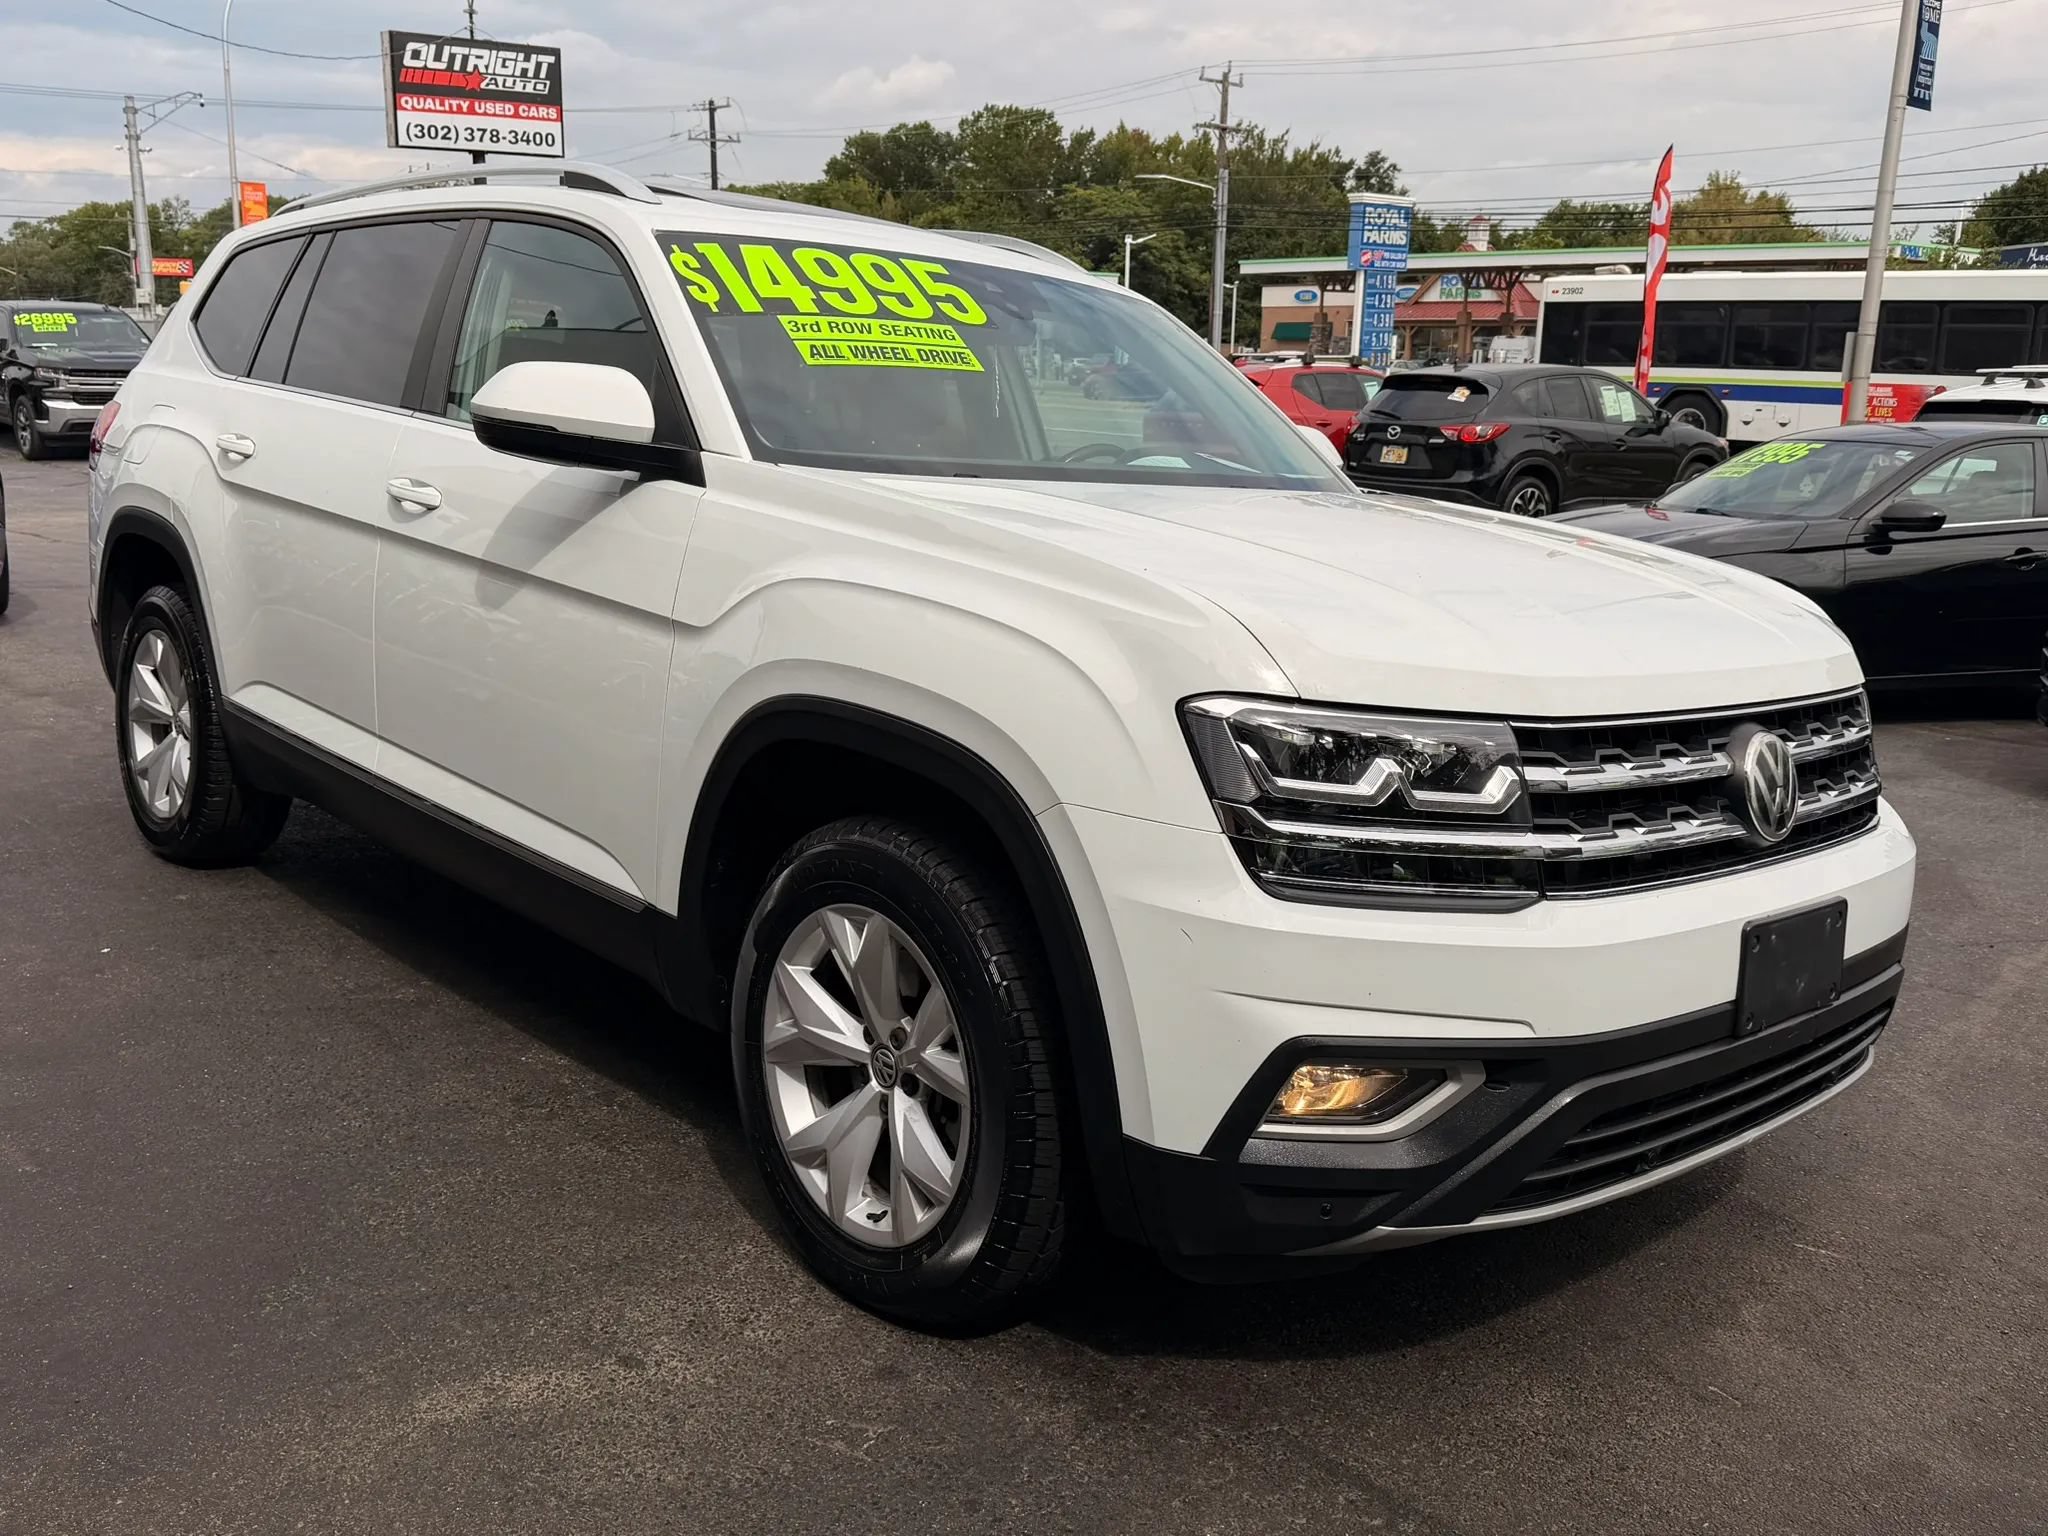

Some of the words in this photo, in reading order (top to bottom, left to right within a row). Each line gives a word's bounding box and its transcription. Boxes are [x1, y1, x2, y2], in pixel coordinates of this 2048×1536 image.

[402, 42, 556, 79] OUTRIGHT
[484, 76, 549, 93] AUTO
[400, 96, 470, 113] QUALITY
[475, 100, 515, 116] USED
[518, 105, 558, 119] CARS
[406, 122, 459, 144] (302)
[463, 126, 556, 147] 378-3400
[1364, 206, 1408, 227] ROYAL
[1363, 225, 1407, 245] FARMS
[669, 242, 988, 326] $14995
[1562, 287, 1584, 295] 23902
[13, 312, 78, 326] $26995
[787, 320, 822, 334] 3rd
[827, 321, 873, 335] ROW
[878, 323, 957, 341] SEATING
[809, 343, 847, 361] ALL
[847, 344, 915, 363] WHEEL
[916, 348, 972, 366] DRIVE
